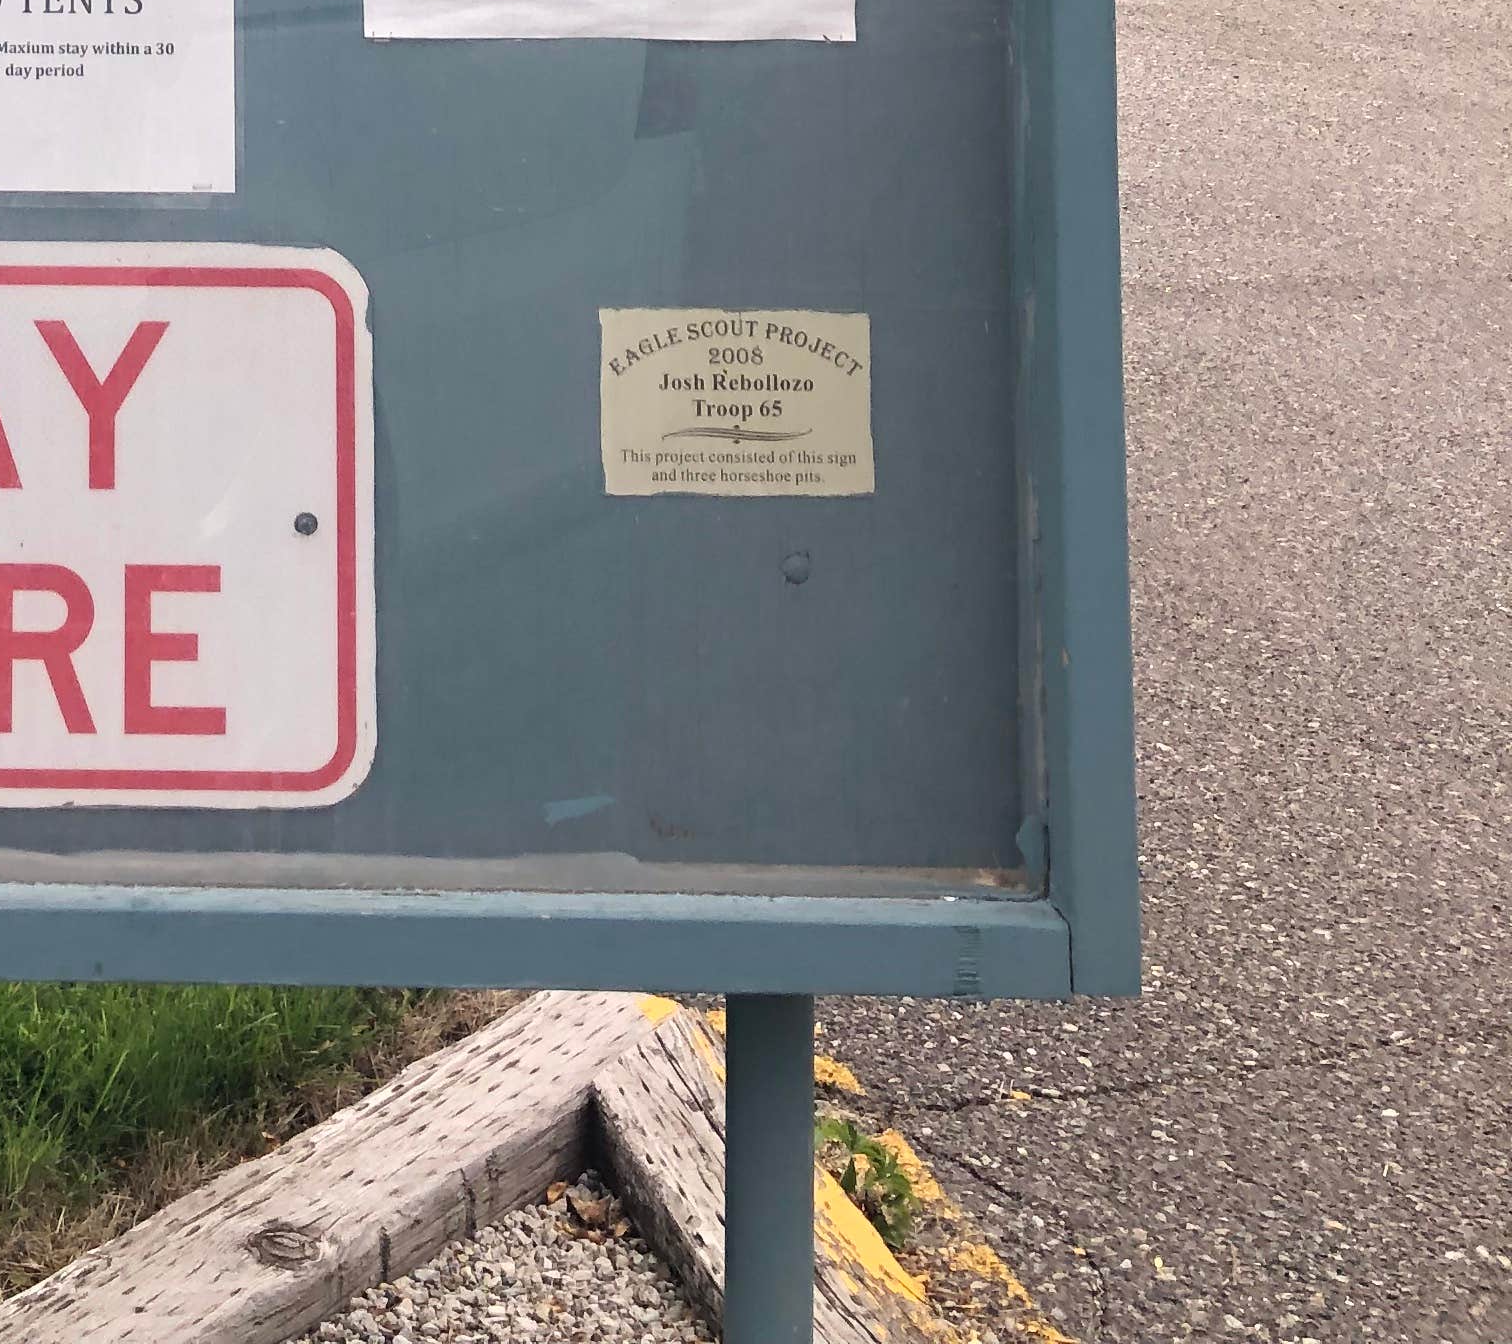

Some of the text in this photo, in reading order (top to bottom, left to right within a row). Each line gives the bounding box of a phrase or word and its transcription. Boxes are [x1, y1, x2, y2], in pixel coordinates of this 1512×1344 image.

[58, 43, 88, 57] stay
[92, 41, 140, 55] within
[143, 45, 152, 55] a
[155, 42, 175, 56] 30
[5, 63, 85, 80] day period
[608, 319, 864, 379] EAGLE SCOUT PROJECT
[708, 345, 764, 365] 2008
[658, 372, 815, 393] Josh Rebollozo
[692, 399, 784, 422] Troop 65
[621, 448, 857, 467] This project consisted of this sign
[651, 468, 677, 482] and
[681, 468, 717, 482] three
[720, 469, 791, 483] horseshoe
